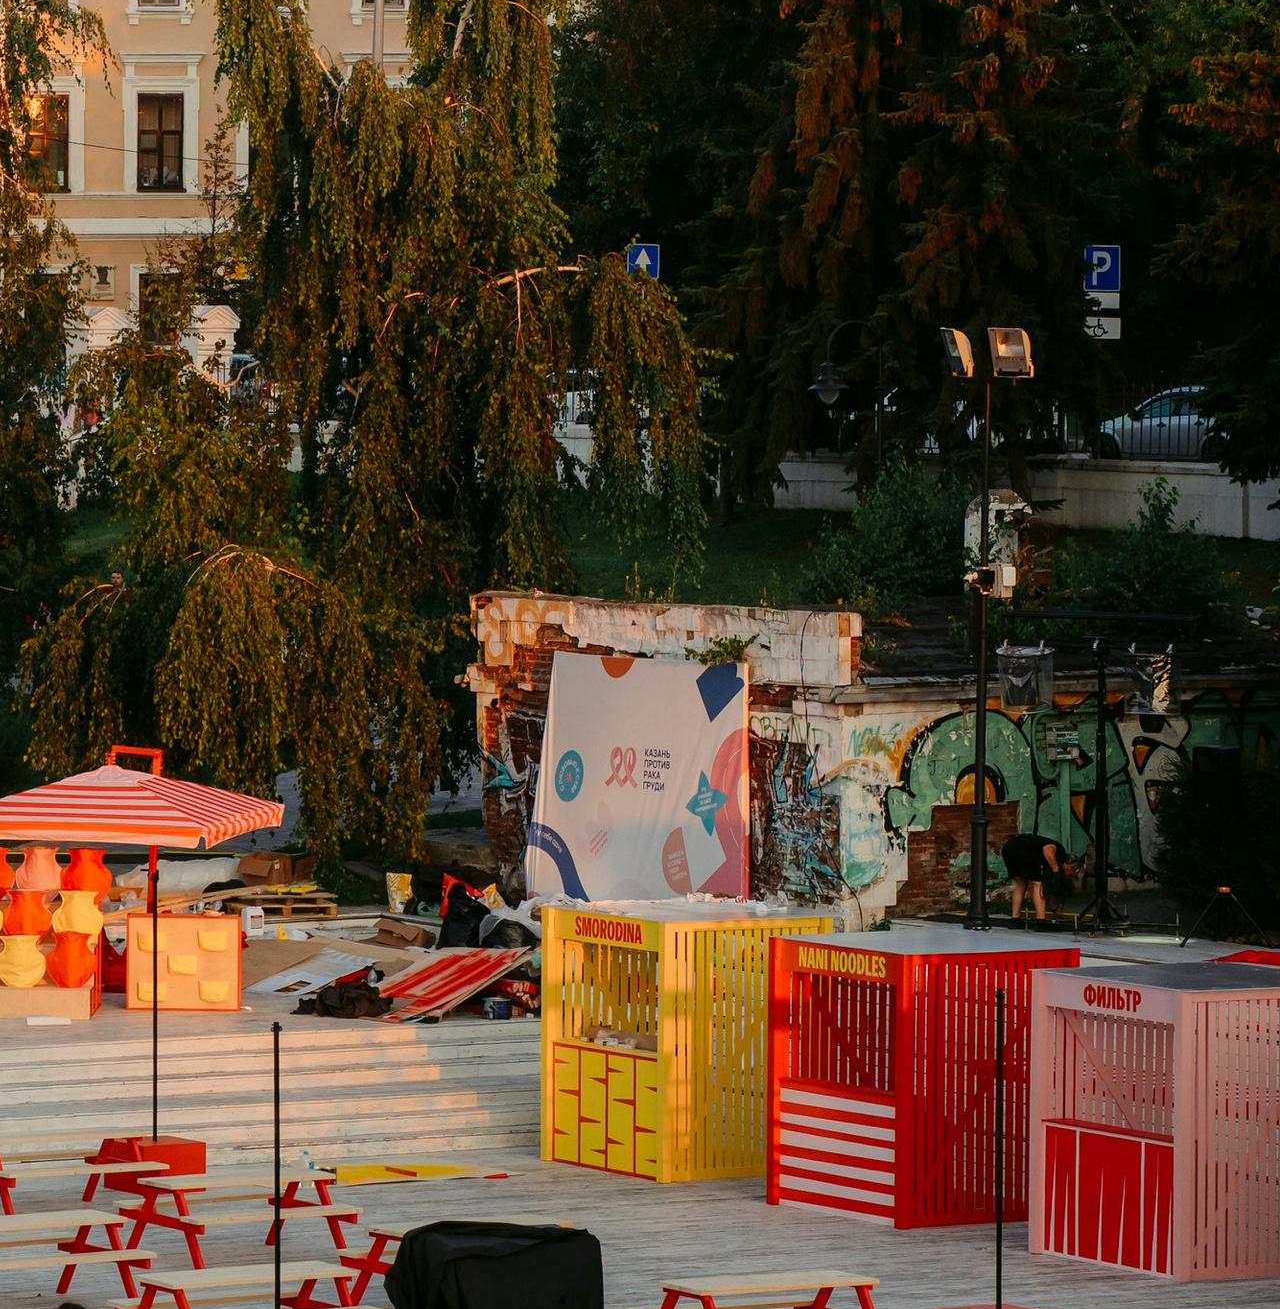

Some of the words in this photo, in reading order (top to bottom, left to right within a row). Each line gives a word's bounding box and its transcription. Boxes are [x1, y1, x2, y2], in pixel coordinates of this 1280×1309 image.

[1092, 251, 1112, 286] P
[644, 748, 671, 759] КАЗАНЬ
[643, 759, 671, 770] ПРОТИВ
[643, 770, 661, 780] РАКА
[642, 781, 665, 792] ГРУДИ
[575, 915, 643, 945] SMORODINA
[798, 946, 828, 970] NANI
[830, 950, 887, 978] NOODLES
[1083, 984, 1142, 1013] ФИЛЬТР
